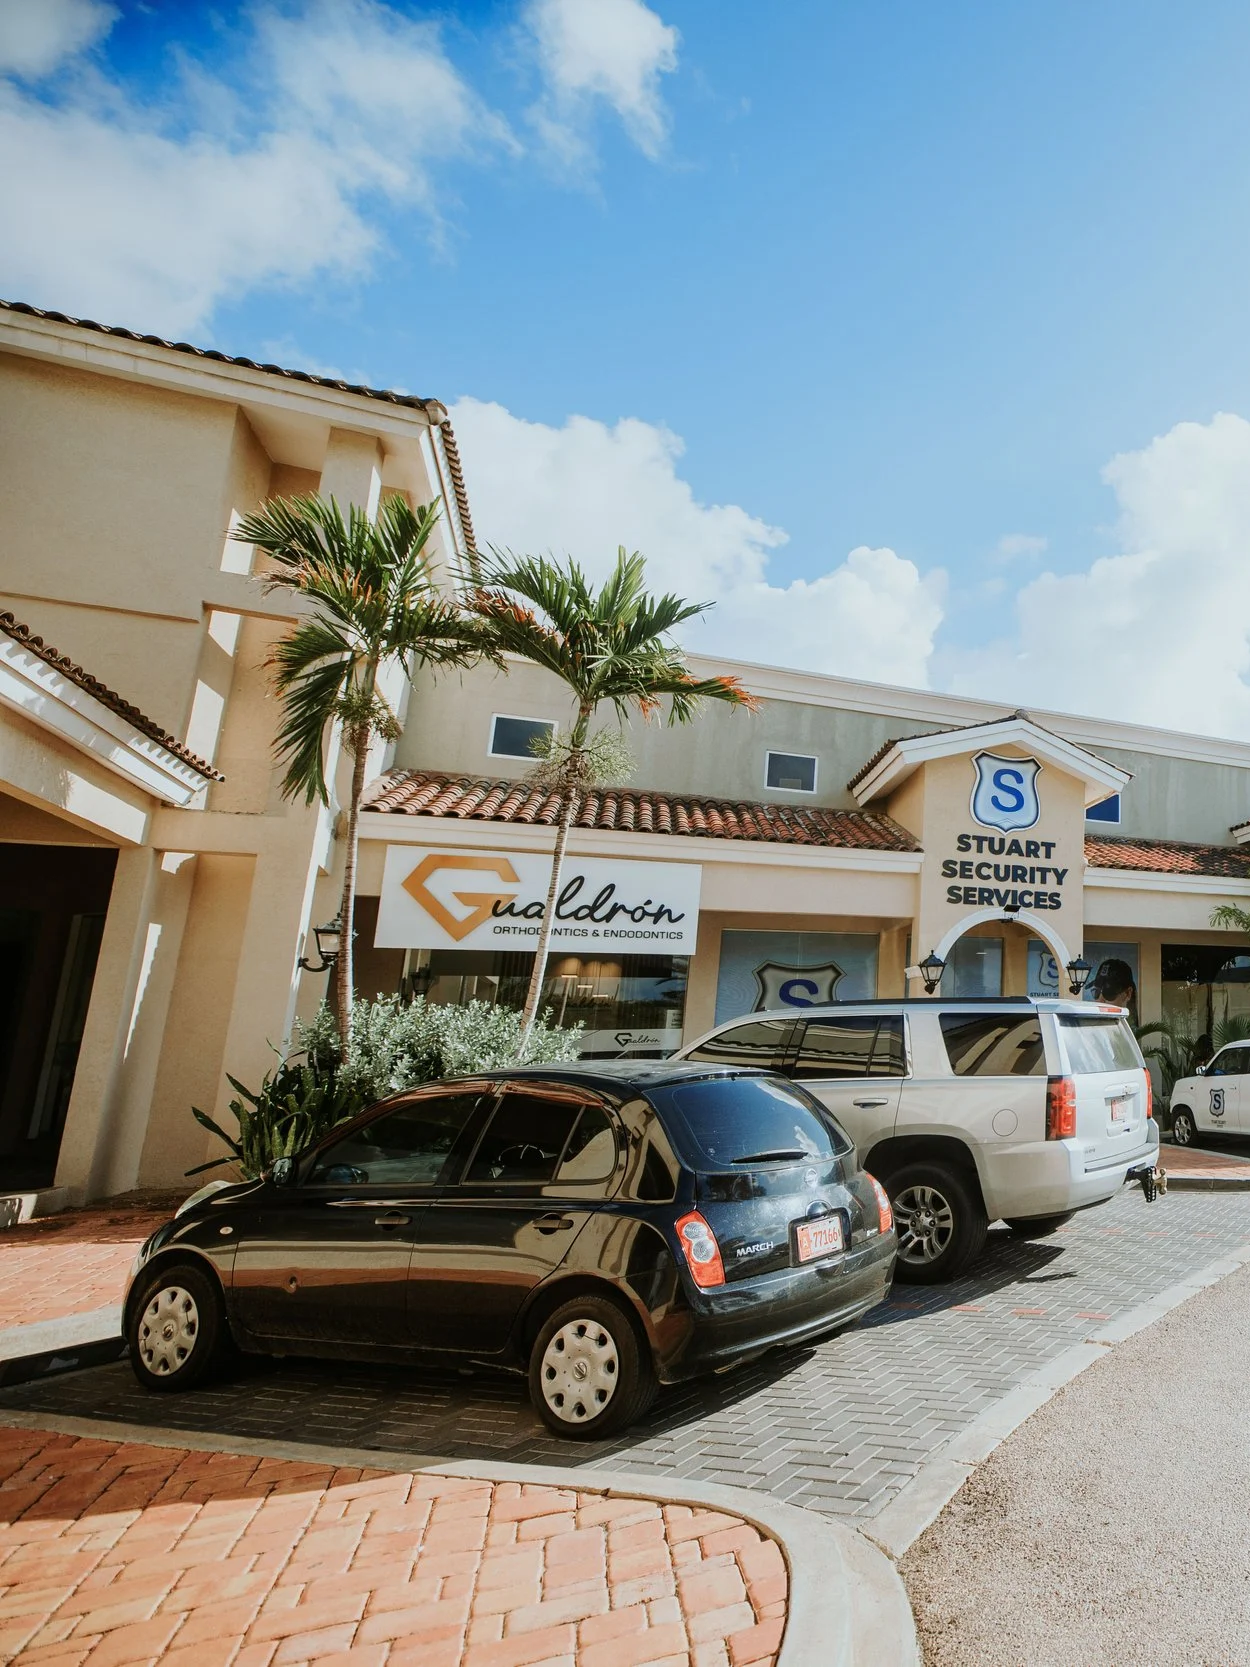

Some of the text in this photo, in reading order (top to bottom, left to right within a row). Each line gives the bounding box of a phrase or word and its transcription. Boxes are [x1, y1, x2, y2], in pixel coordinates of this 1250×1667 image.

[991, 768, 1025, 813] S
[956, 833, 1056, 860] STUART
[941, 859, 1069, 886] SECURITY
[401, 853, 686, 943] Gualdrón
[946, 885, 1062, 910] SERVICES
[493, 925, 684, 940] ORTHODNTICS & ENDODONTICS
[1213, 1093, 1221, 1110] S
[736, 1241, 774, 1257] MARCH
